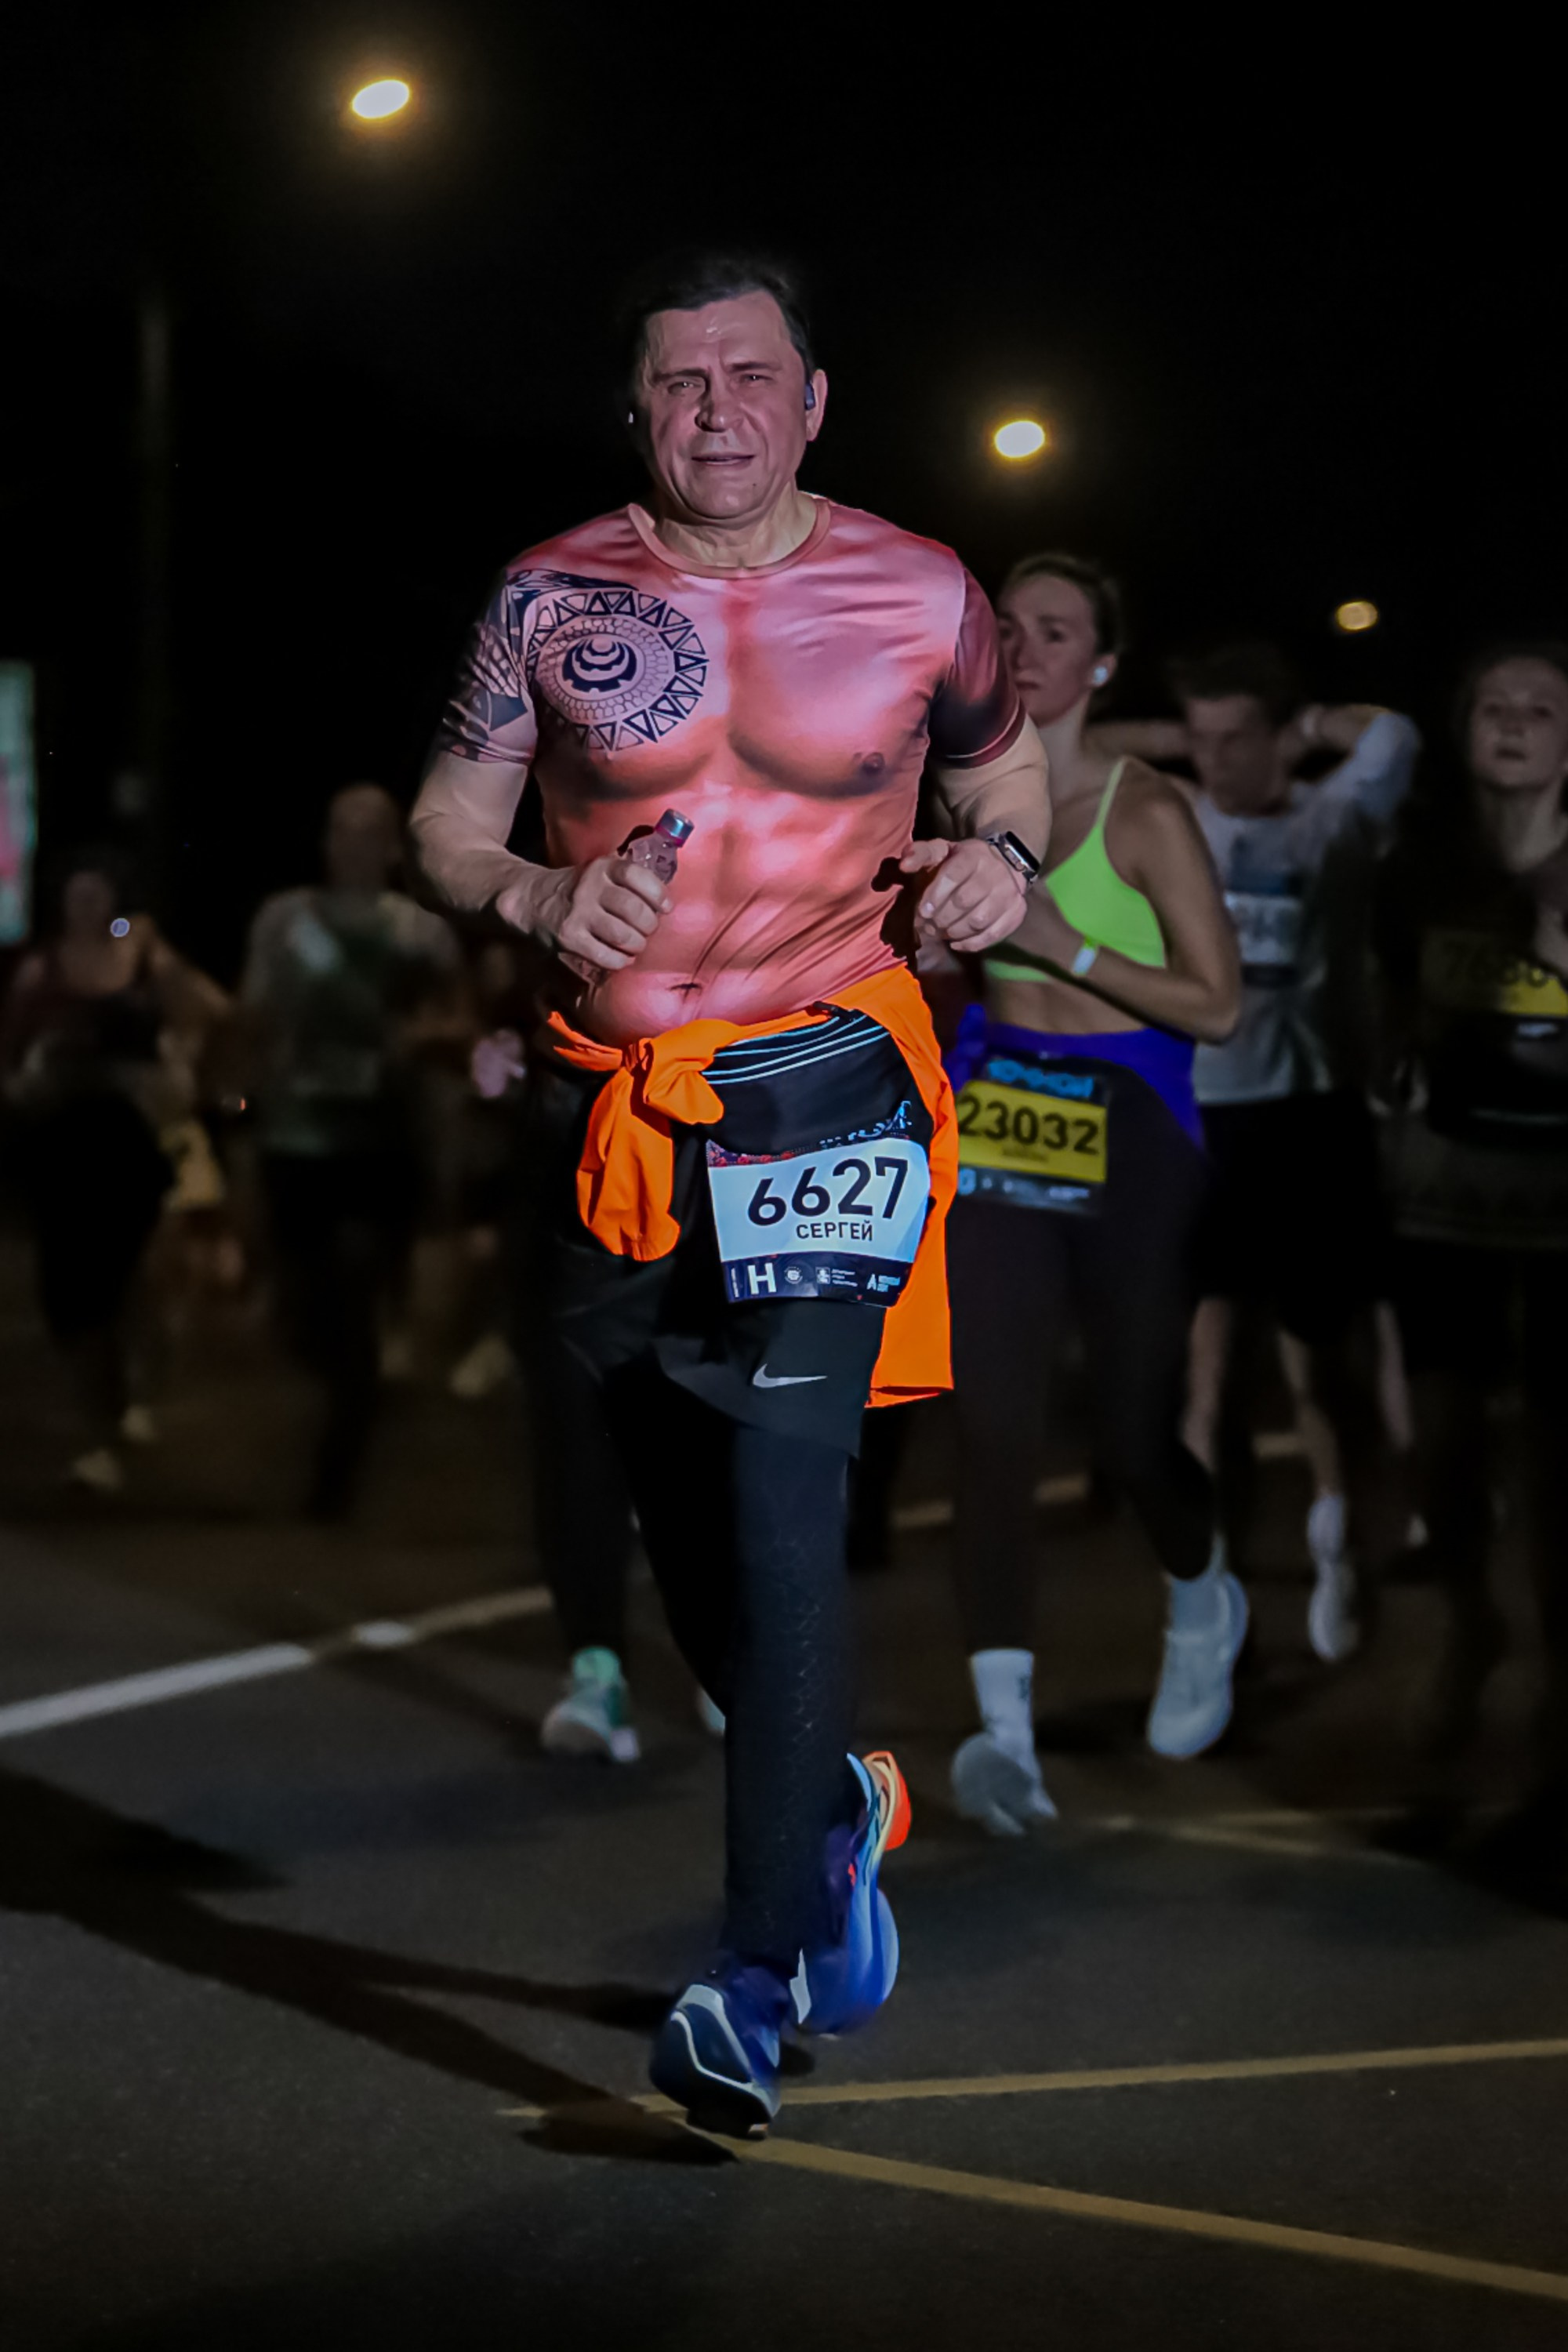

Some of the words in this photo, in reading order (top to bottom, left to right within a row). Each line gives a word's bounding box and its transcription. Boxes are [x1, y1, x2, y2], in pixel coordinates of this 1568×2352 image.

[958, 1094, 1099, 1156] 23032
[747, 1156, 909, 1226] 6627
[796, 1219, 873, 1243] СЕРГЕЙ
